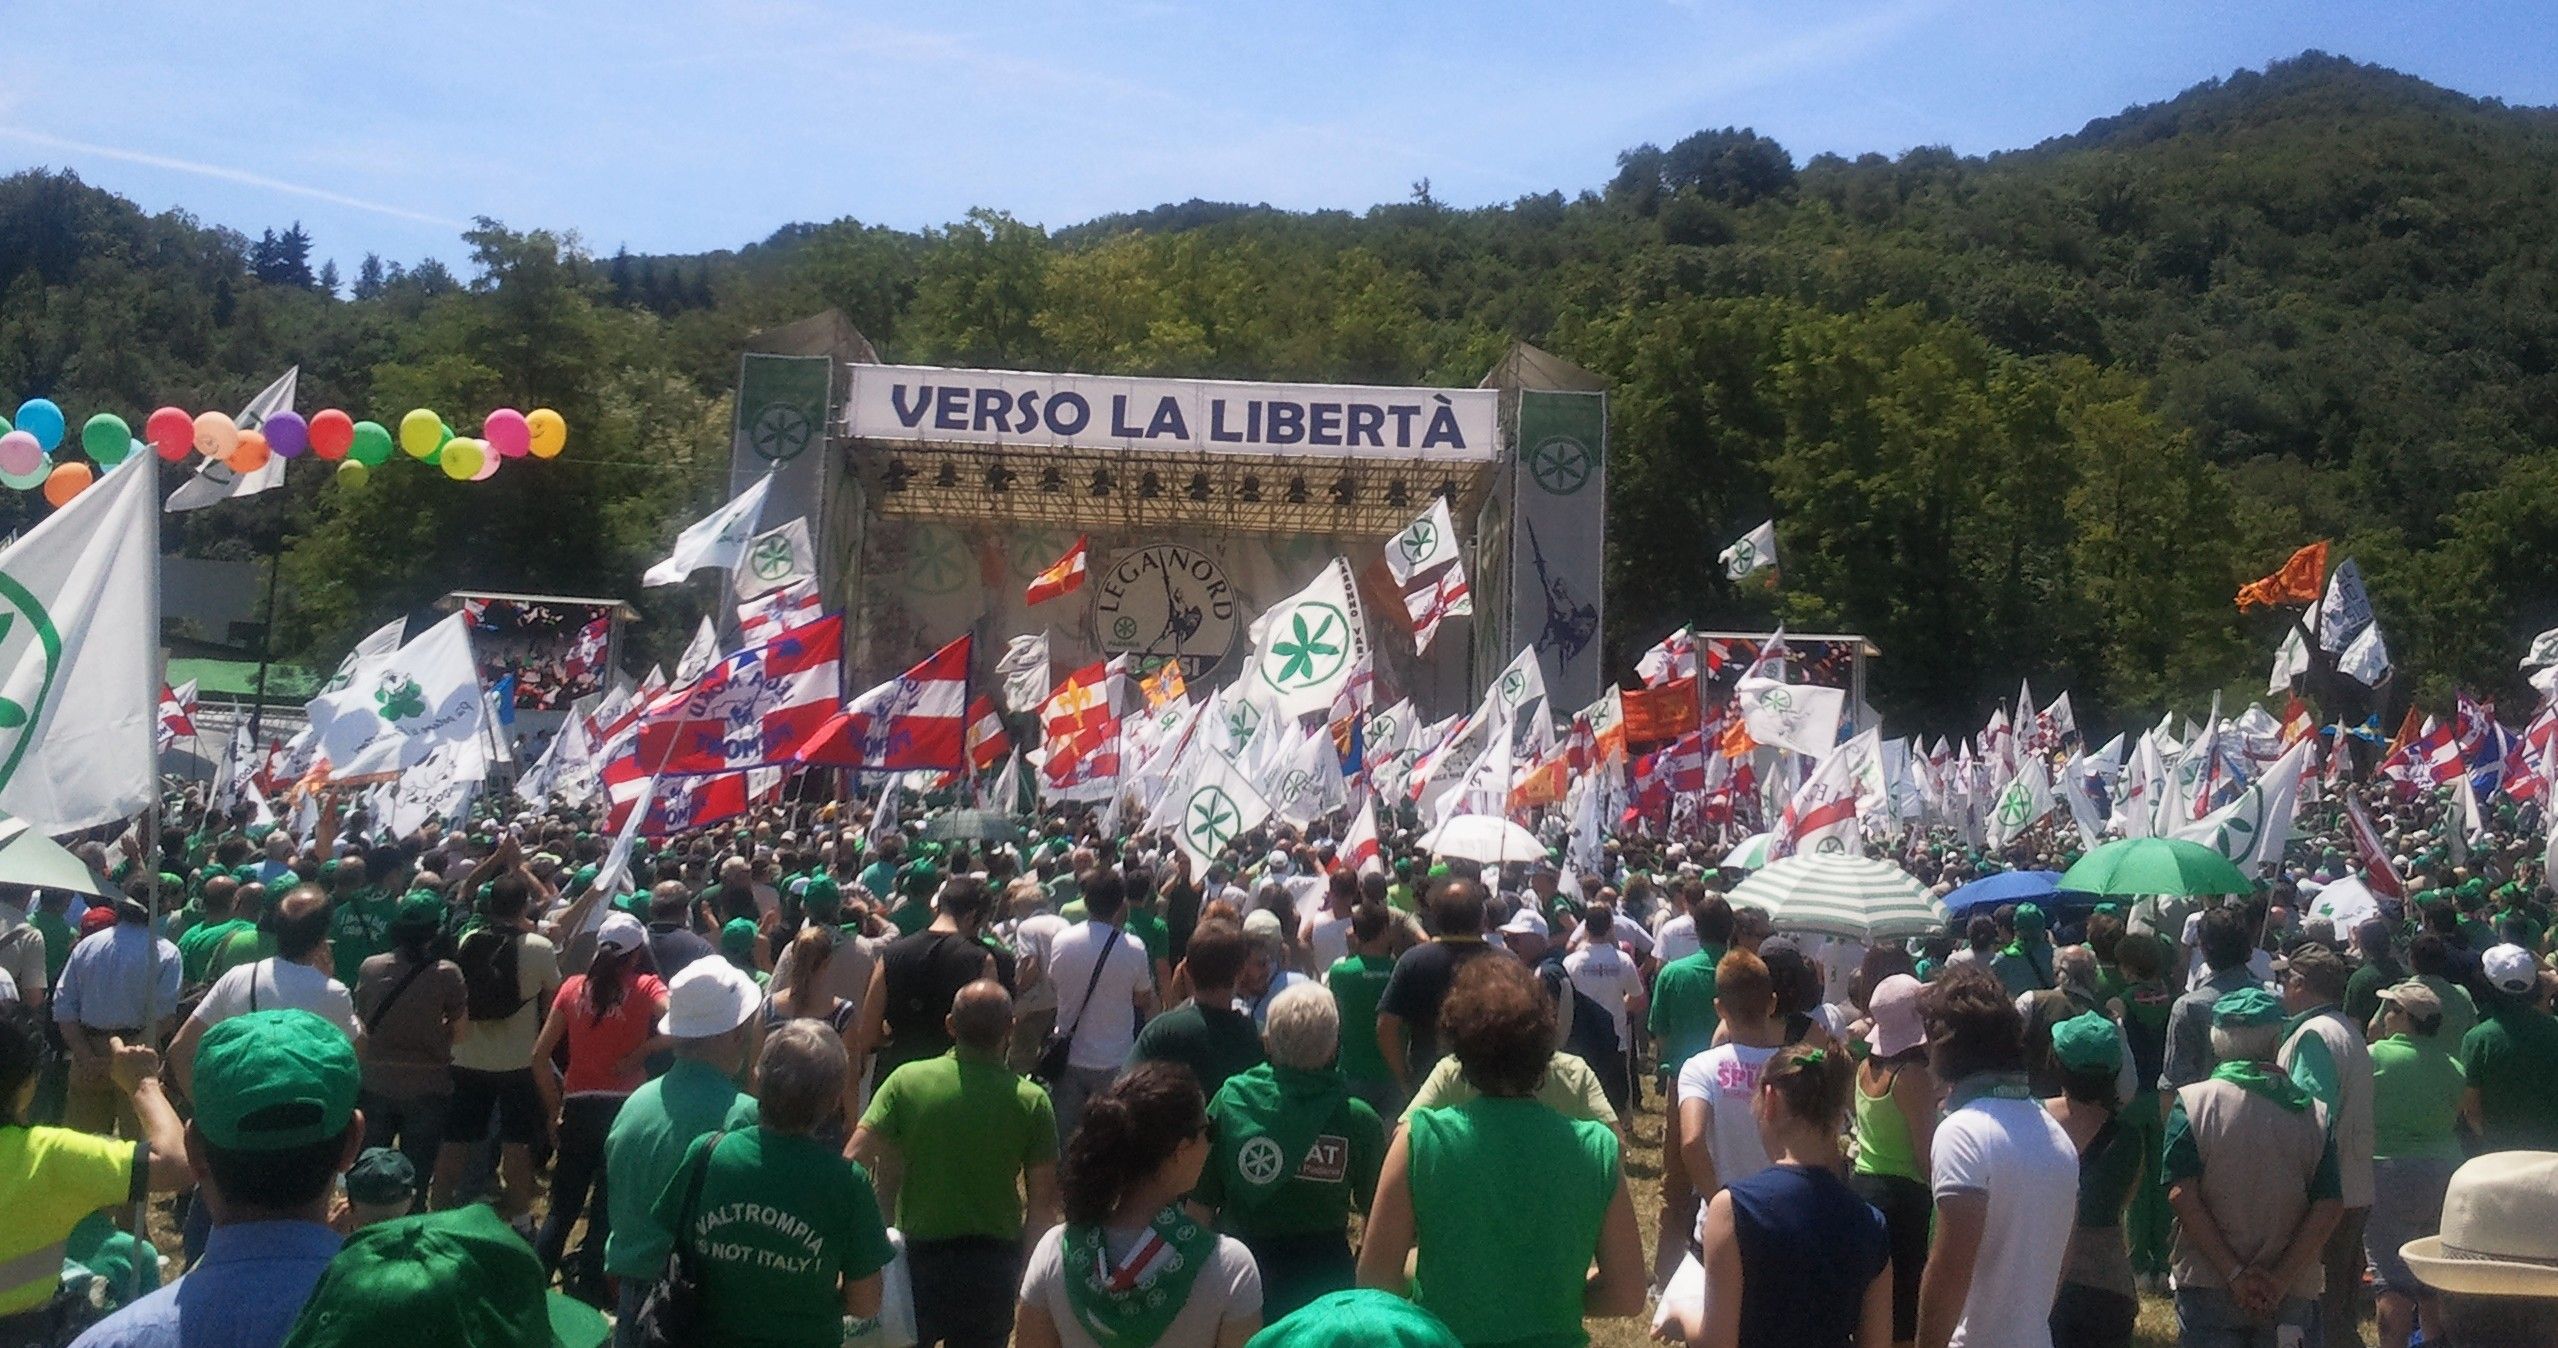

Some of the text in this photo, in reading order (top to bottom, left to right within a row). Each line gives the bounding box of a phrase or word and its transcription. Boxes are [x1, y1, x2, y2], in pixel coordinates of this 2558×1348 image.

[892, 384, 1467, 450] VERSO LA LIBERTÀ
[1099, 548, 1234, 621] LEGA NORD
[695, 1202, 824, 1257] VALTROMPIA
[712, 1242, 754, 1262] NOT
[757, 1249, 811, 1272] ITALY
